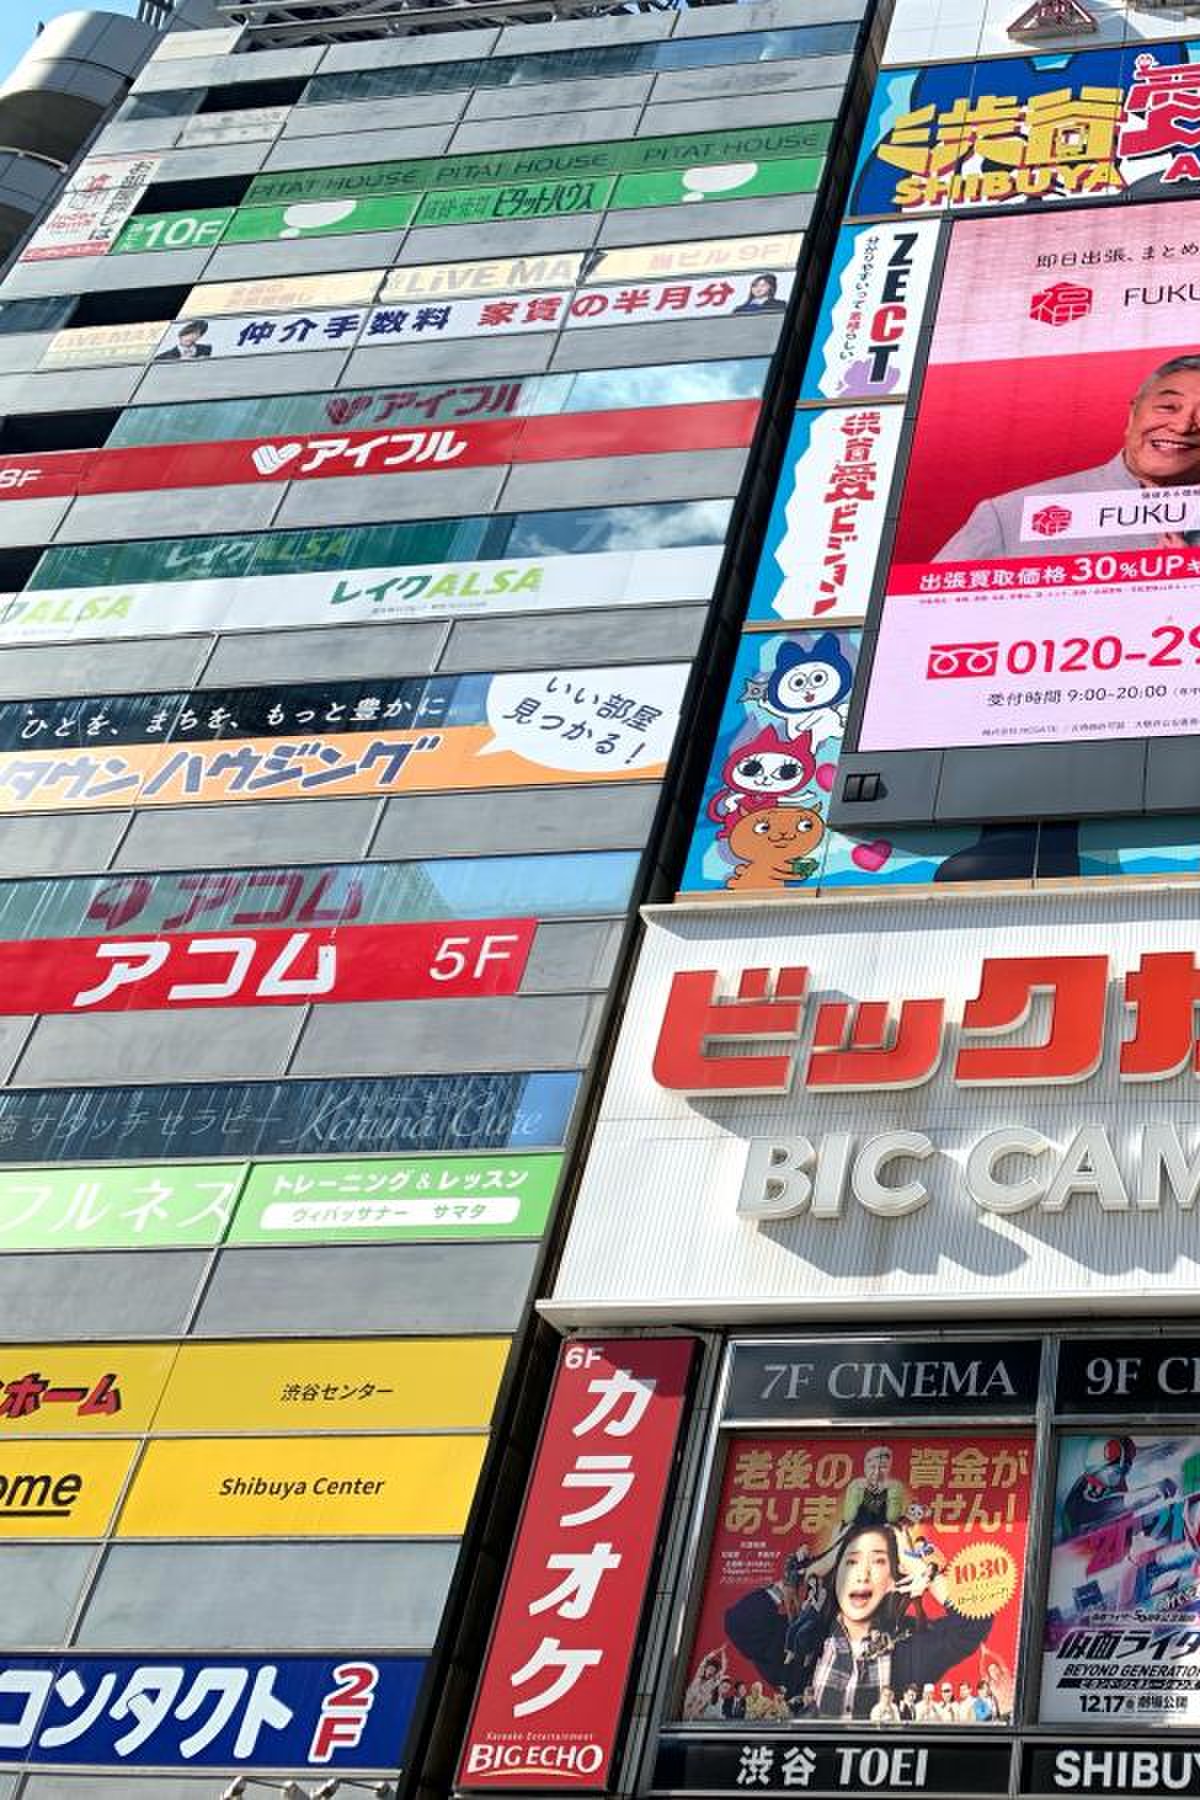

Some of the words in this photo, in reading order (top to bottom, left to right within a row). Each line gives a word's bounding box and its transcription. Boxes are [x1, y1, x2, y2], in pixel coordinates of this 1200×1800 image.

[437, 161, 503, 181] PITAT
[516, 153, 610, 175] HOUSE
[643, 142, 714, 162] PITAT
[722, 132, 819, 155] HOUSE
[250, 176, 315, 199] PITAT
[326, 169, 417, 190] HOUSE
[895, 163, 1128, 208] SHIBUYA
[148, 217, 224, 248] 10F
[237, 303, 453, 347] 仲介手数料
[477, 281, 737, 327] 家賃の半月分
[868, 232, 919, 383] ZECT
[373, 382, 523, 421] アイフル
[300, 429, 469, 472] アイフル
[1099, 503, 1188, 528] FUKU
[331, 568, 545, 604] レイクALSA
[547, 676, 664, 732] いい部屋
[0, 735, 440, 801] タウンハウジング
[163, 873, 361, 928] アコム
[73, 932, 338, 1007] アコム
[428, 934, 518, 982] 5F
[737, 1128, 936, 1224] BIC
[432, 1201, 487, 1222] サマタ
[564, 1346, 602, 1370] 6F
[1085, 1356, 1141, 1397] 9F
[0, 1373, 122, 1418] ホーム
[280, 1381, 394, 1402] 渋谷センター
[761, 1364, 812, 1401] 7F
[827, 1359, 1017, 1400] CINEMA
[219, 1475, 305, 1500] Shibuya
[311, 1475, 386, 1497] Center
[733, 1449, 853, 1491] 老後の
[909, 1447, 1029, 1490] 資金が
[510, 1369, 657, 1719] カラオケ
[1063, 1664, 1119, 1679] BEYOND
[0, 1664, 293, 1759] コンタクト
[309, 1661, 379, 1764] 2F
[1079, 1695, 1124, 1713] 12.17
[467, 1743, 523, 1774] BIG
[525, 1743, 604, 1774] ECHO
[736, 1745, 818, 1786] 渋谷
[836, 1747, 929, 1788] TOEI
